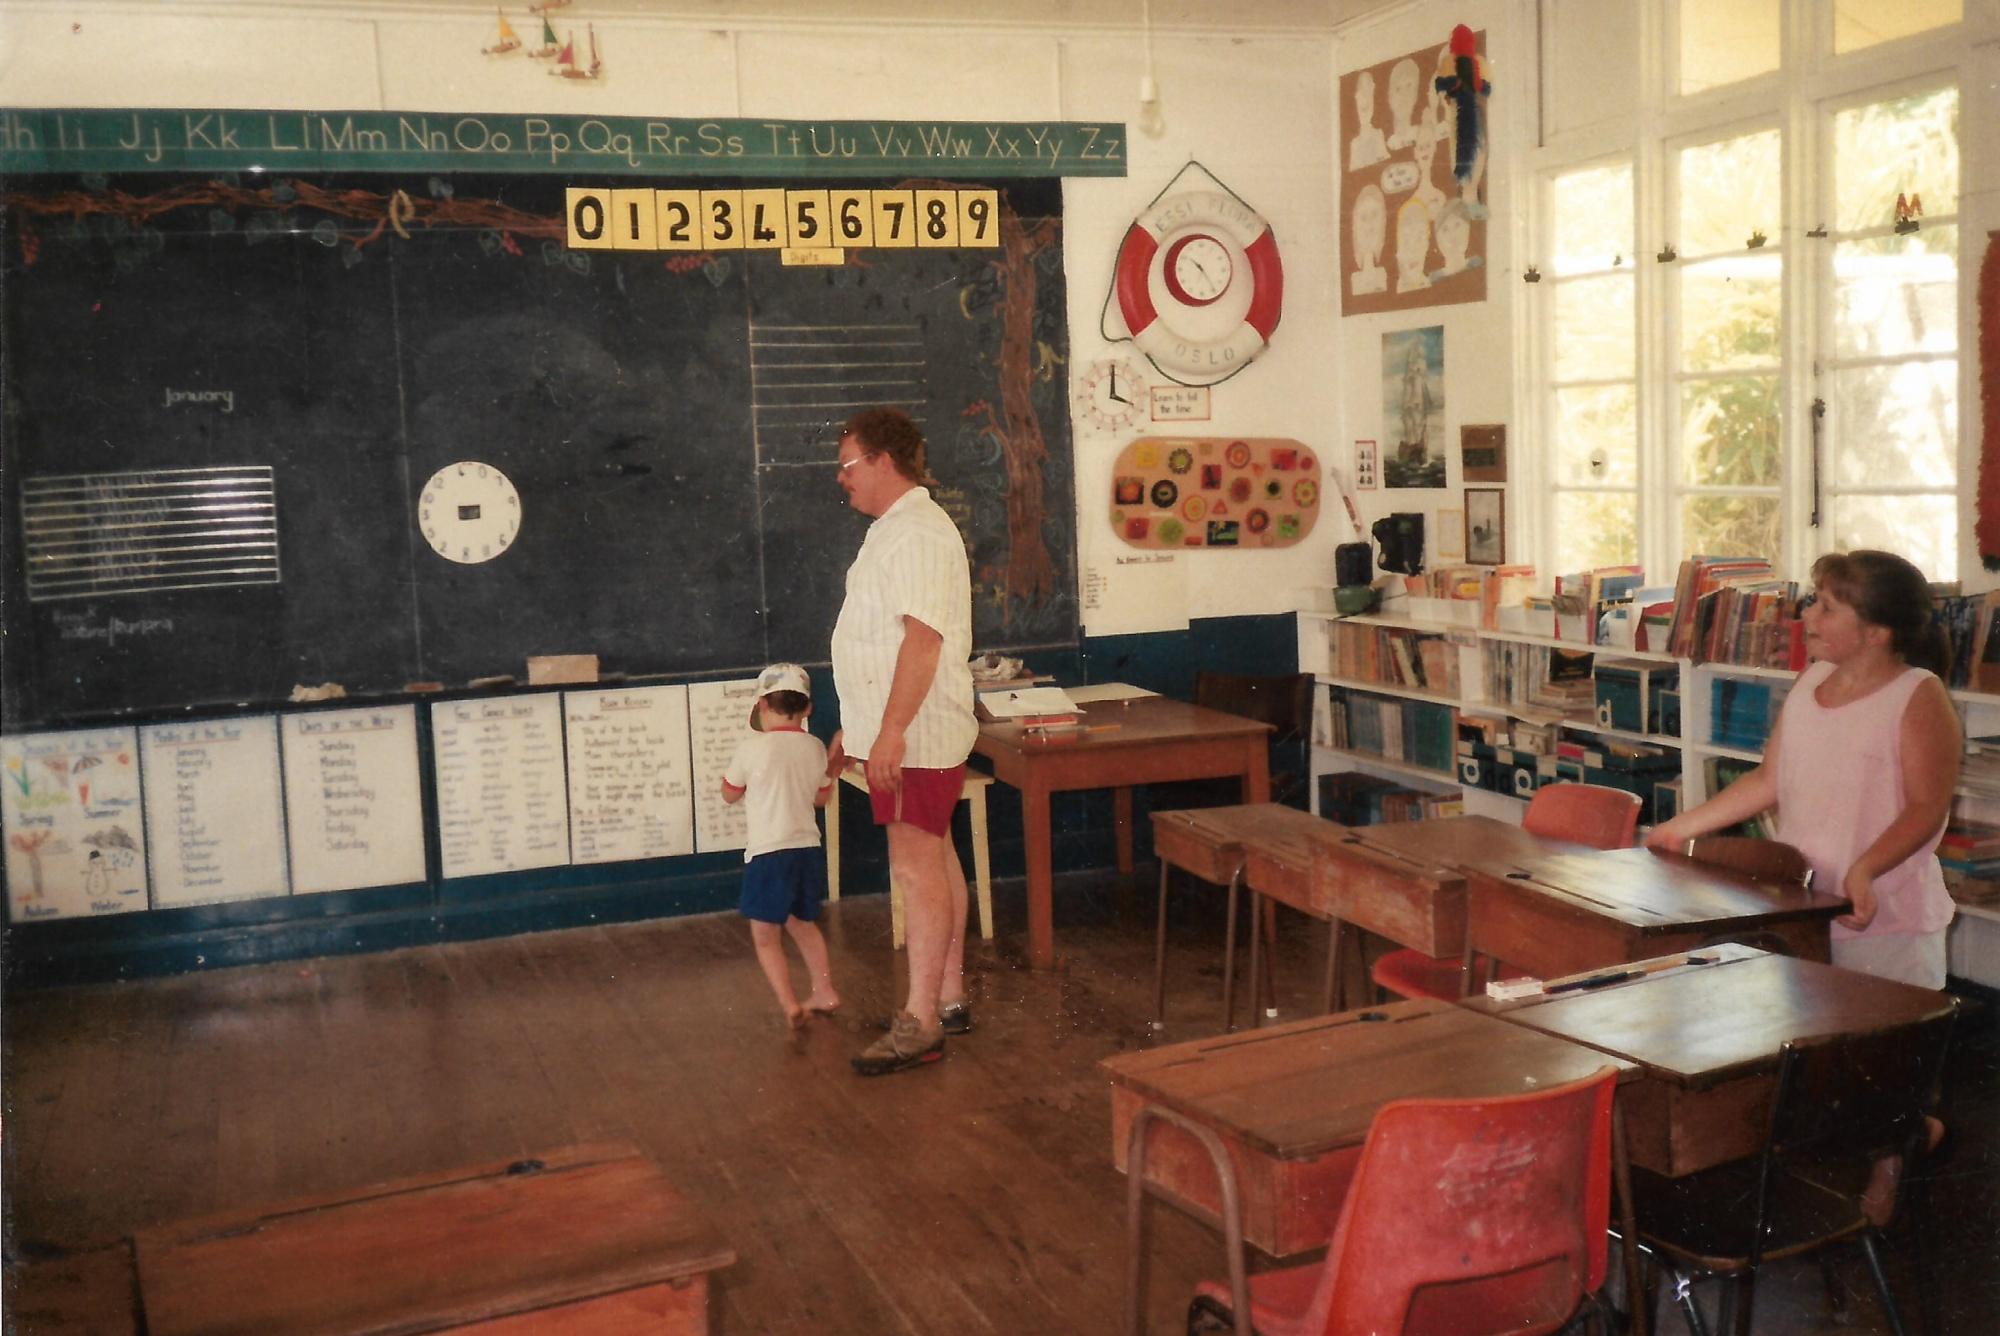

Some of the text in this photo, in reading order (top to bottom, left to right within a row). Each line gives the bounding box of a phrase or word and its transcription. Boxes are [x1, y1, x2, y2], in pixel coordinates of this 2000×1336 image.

[119, 113, 162, 162] Jj
[185, 114, 241, 150] Kk
[269, 115, 310, 150] Ll
[320, 116, 388, 151] Mm
[400, 117, 448, 151] Nn
[454, 118, 511, 152] Oo
[525, 119, 570, 164] Pp
[578, 120, 641, 168] Qq
[646, 122, 690, 156] Rr
[697, 123, 744, 157] Ss
[763, 123, 801, 157] Tt
[811, 125, 857, 158] Uu
[871, 126, 912, 158] Vv
[918, 126, 973, 158] Ww
[985, 126, 1022, 159] Xx
[1026, 127, 1063, 169] Yy
[1080, 127, 1121, 159] Zz
[573, 195, 988, 242] 0 1 2 3 4 5 6 7 8 9
[1175, 344, 1235, 365] OSLO
